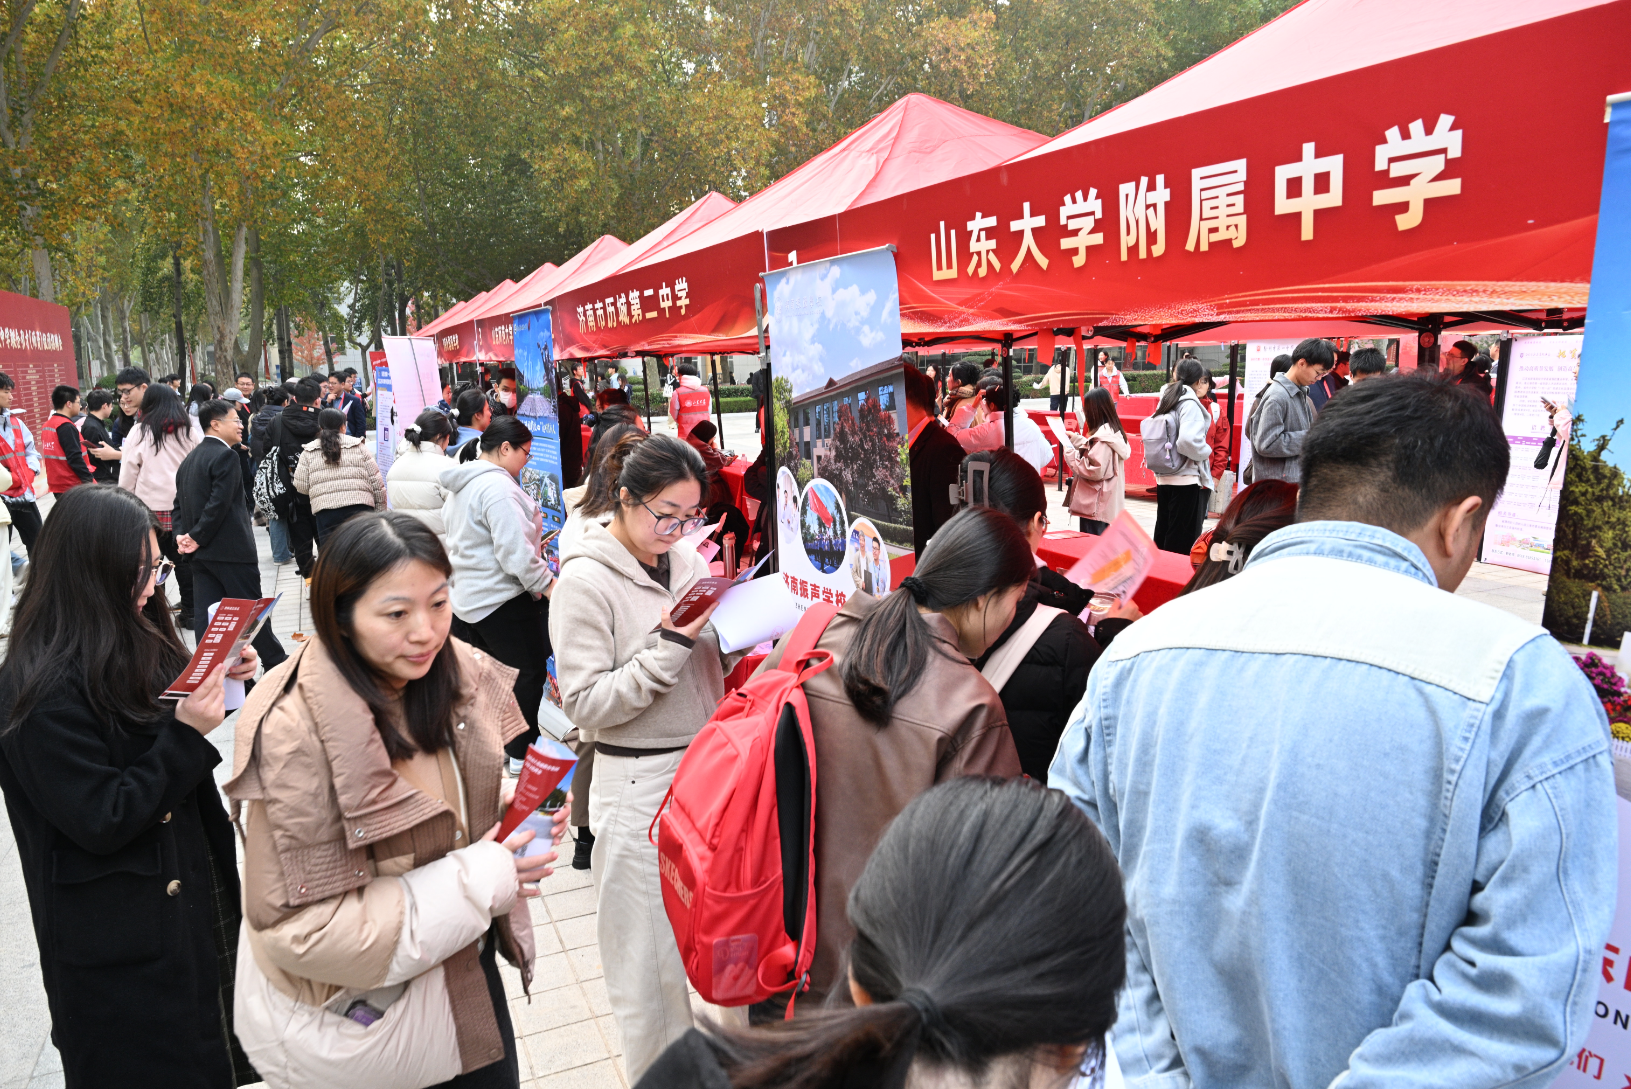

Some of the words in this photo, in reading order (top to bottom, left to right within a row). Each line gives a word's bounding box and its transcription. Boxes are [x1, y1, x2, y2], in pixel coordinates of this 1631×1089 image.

[930, 113, 1462, 281] 山东大学附属中学
[576, 276, 690, 333] 济南市历城第二中学
[782, 571, 847, 608] 济南振声学校
[1570, 1047, 1605, 1081] 们
